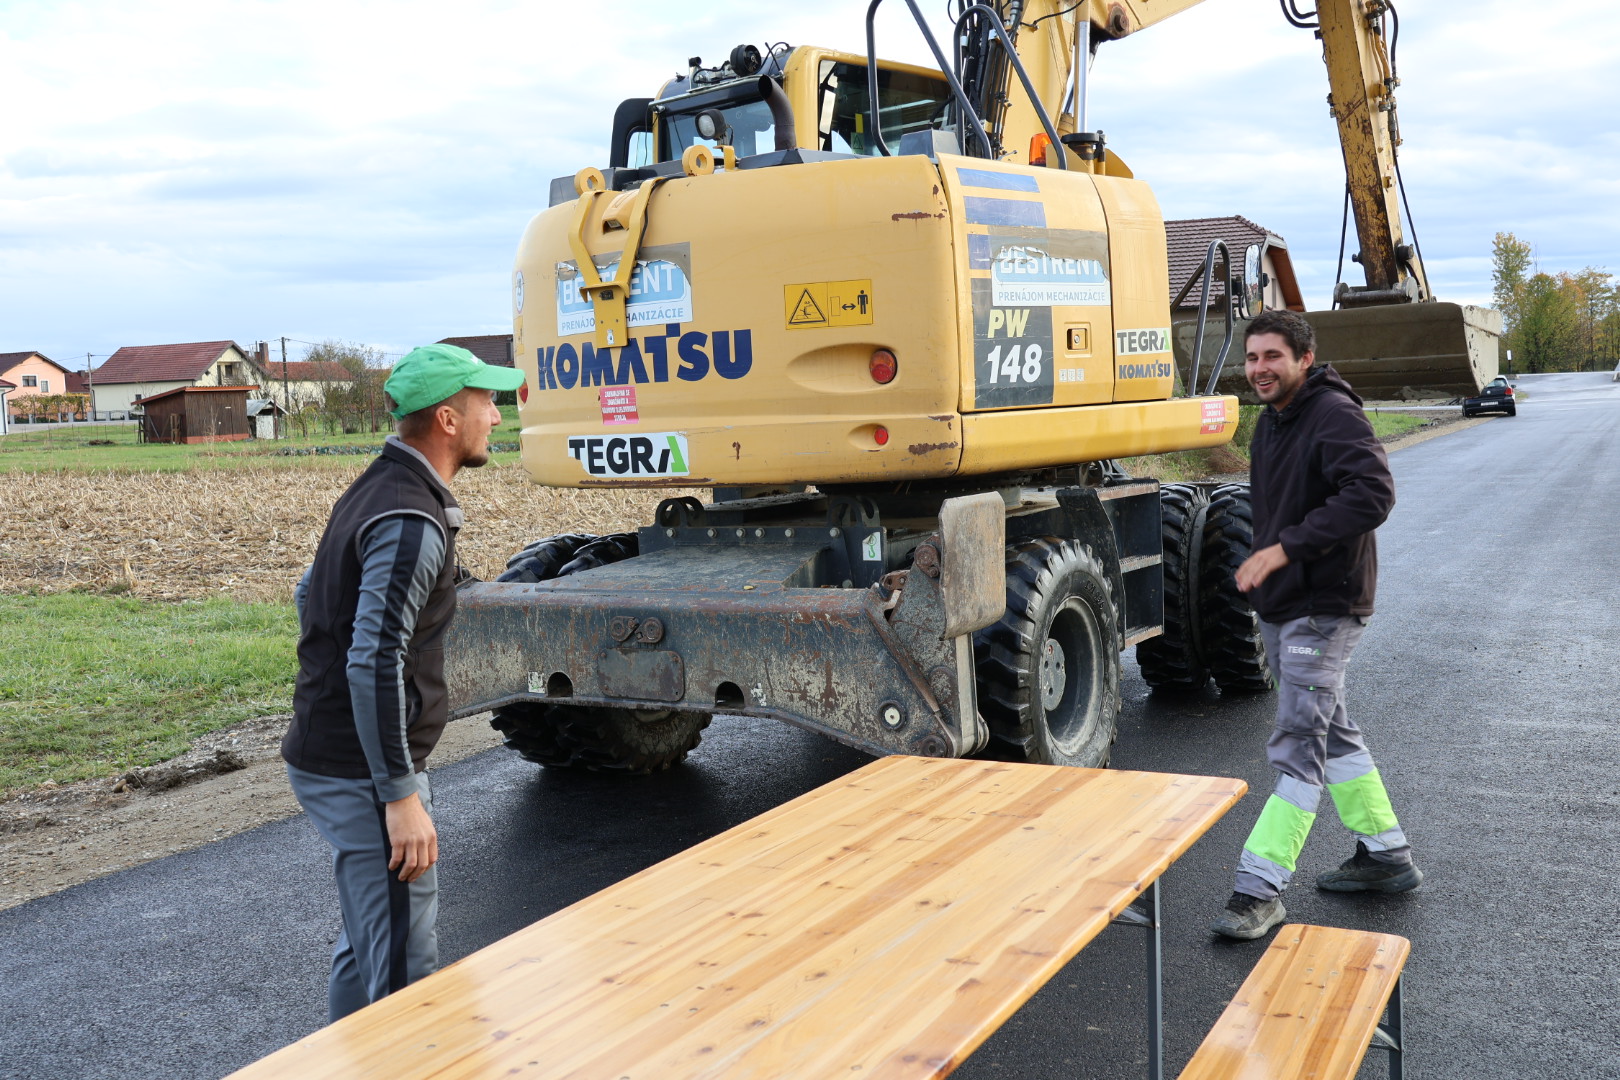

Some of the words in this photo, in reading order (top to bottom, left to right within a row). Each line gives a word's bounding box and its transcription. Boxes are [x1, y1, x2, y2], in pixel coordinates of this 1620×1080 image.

[998, 288, 1044, 301] PRENÁJOM
[1046, 288, 1106, 301] MECHANIZÁCIE
[562, 316, 595, 331] PRENÁJO
[987, 309, 1030, 338] PW
[1117, 330, 1170, 353] TEGRA
[537, 323, 753, 390] KOMATSU
[988, 343, 1042, 383] 148
[1119, 360, 1171, 379] KOMATSU
[569, 435, 688, 474] TEGRA
[1287, 645, 1321, 656] TEGRA
